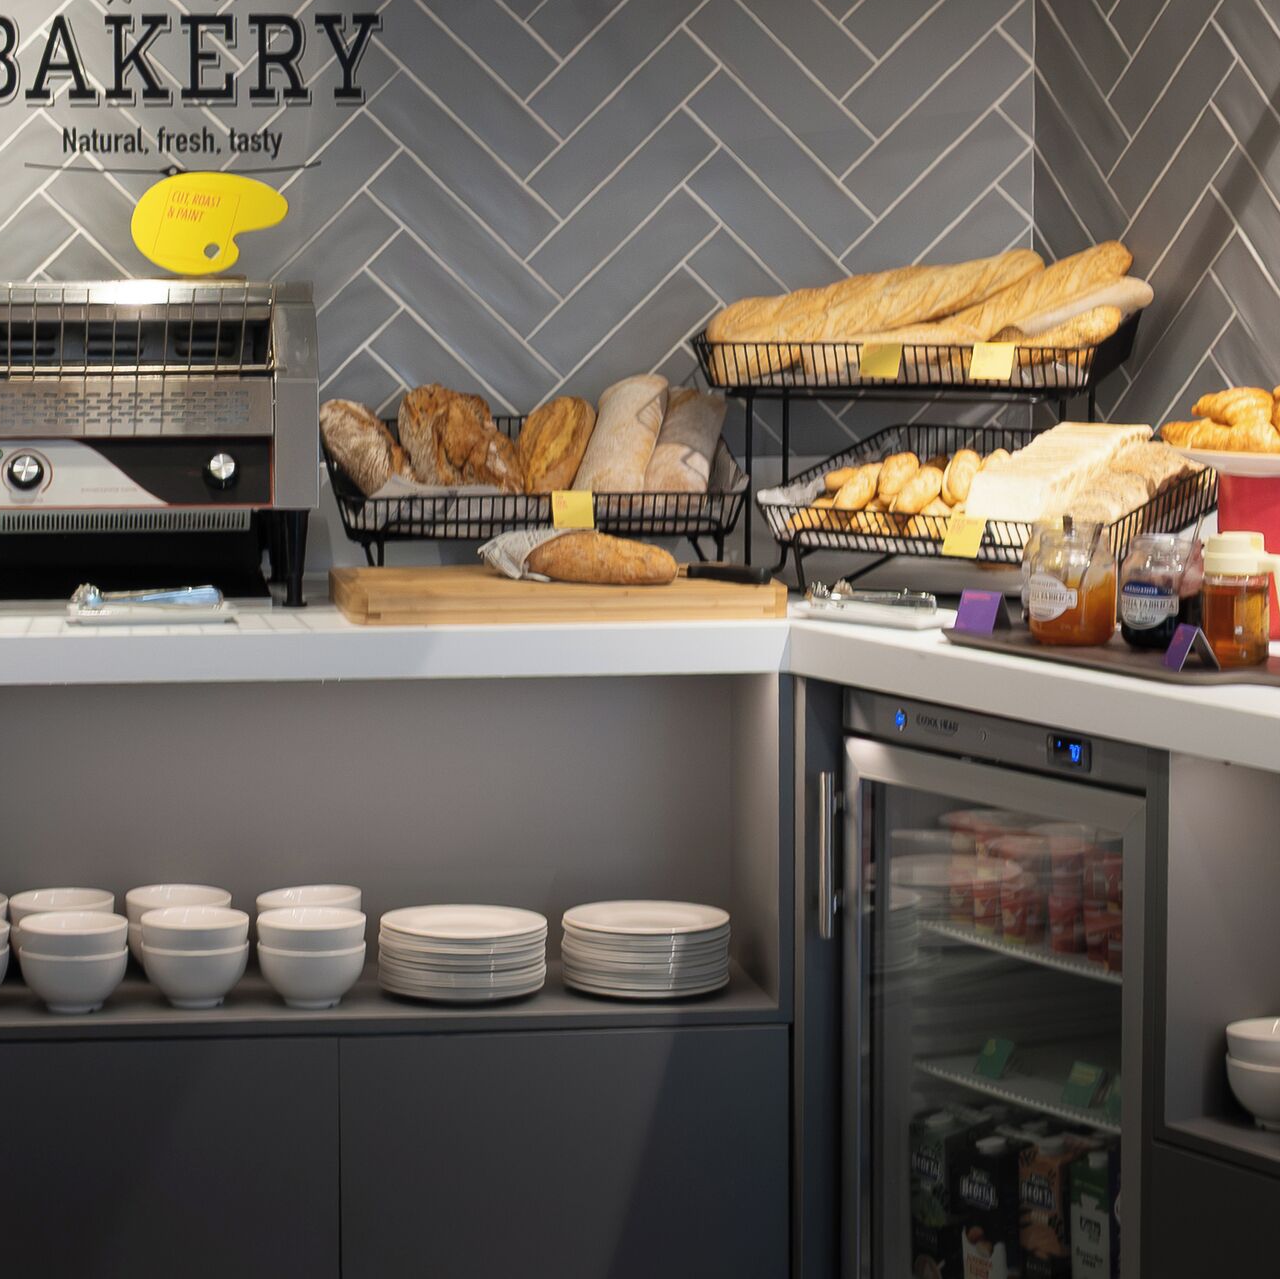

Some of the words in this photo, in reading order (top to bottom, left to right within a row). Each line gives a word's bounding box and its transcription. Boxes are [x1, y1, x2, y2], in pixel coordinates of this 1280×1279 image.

[62, 127, 149, 155] Natural,
[158, 126, 221, 155] fresh,
[229, 127, 283, 159] tasty
[192, 194, 222, 208] ROAST
[176, 207, 204, 222] PAINT
